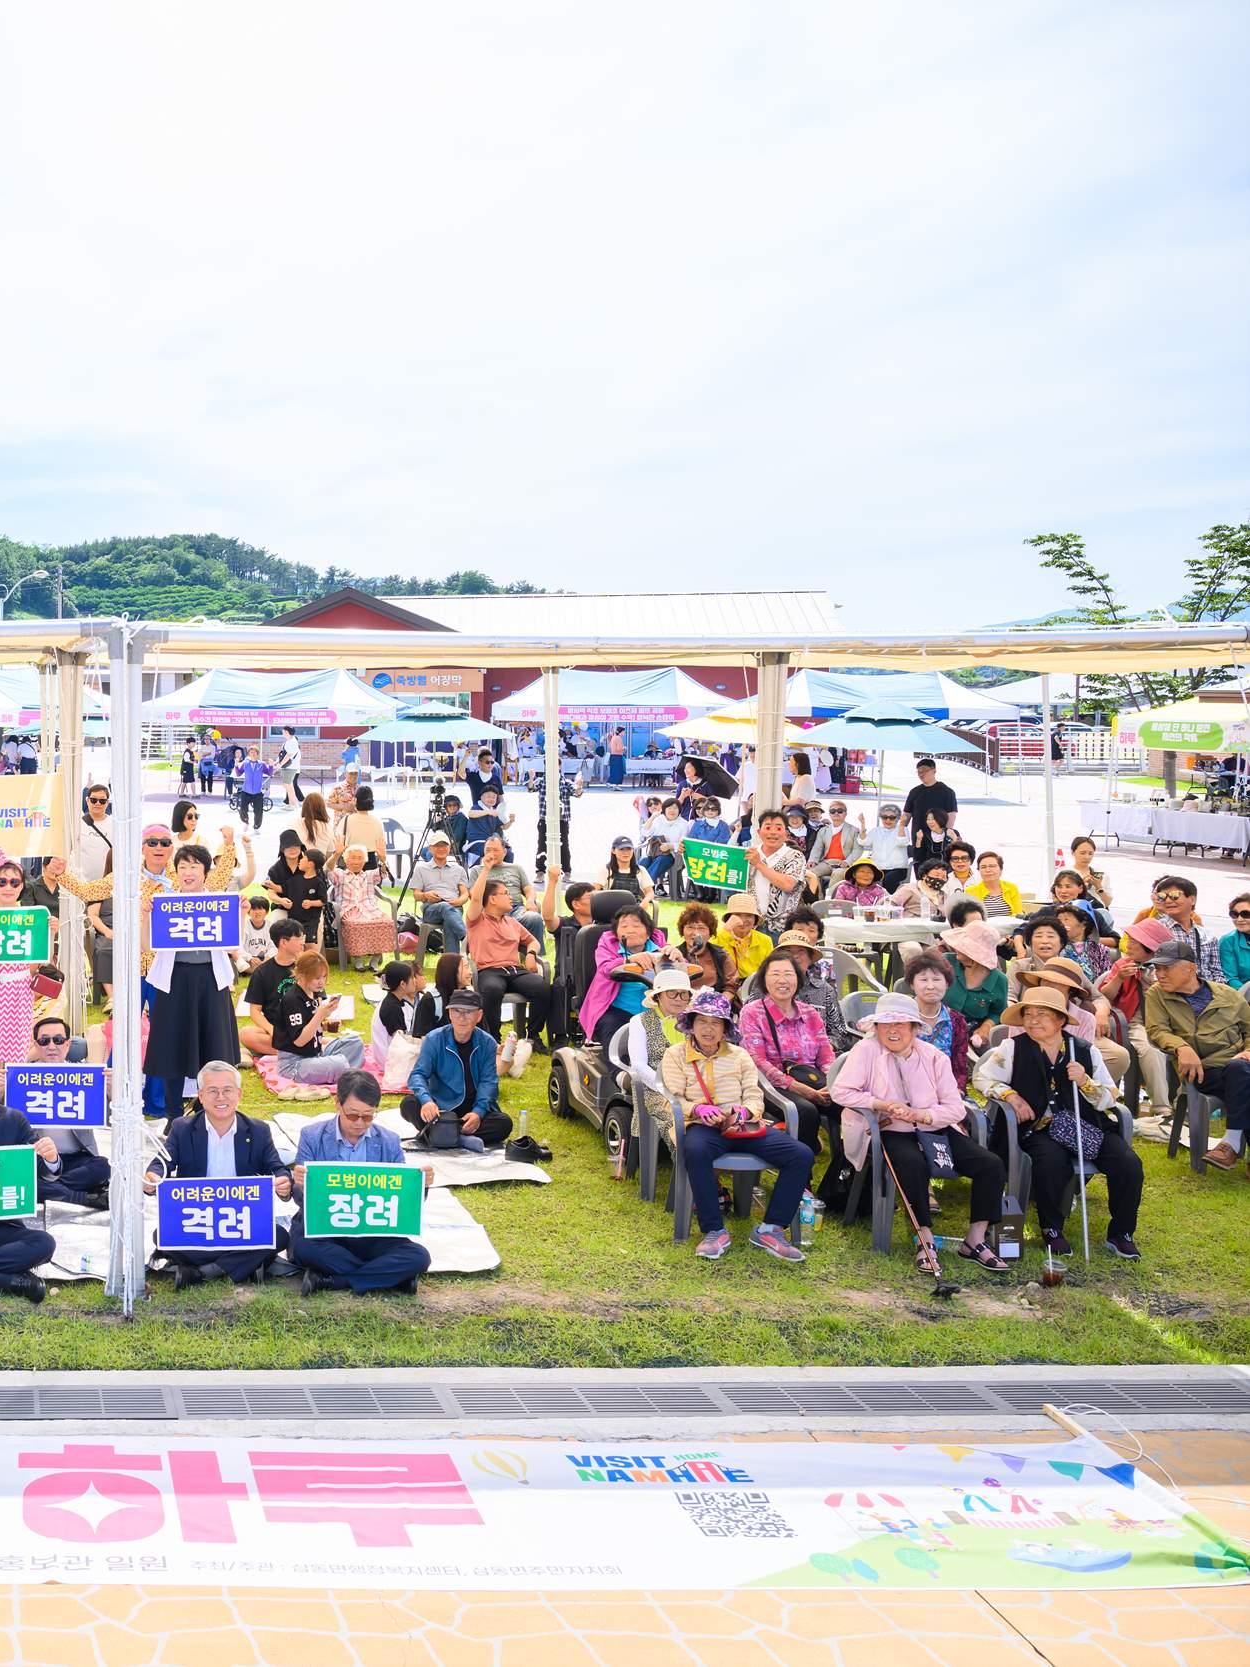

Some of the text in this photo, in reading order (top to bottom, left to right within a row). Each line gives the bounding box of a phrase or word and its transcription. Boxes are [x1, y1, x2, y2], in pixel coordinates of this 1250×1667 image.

[430, 675, 463, 686] 어장막
[702, 847, 729, 860] 모범은
[688, 857, 742, 885] 장려를!
[162, 901, 229, 912] 어려운이에겐
[169, 916, 222, 942] 격려
[289, 1013, 303, 1026] 99
[18, 1074, 93, 1085] 어려운이에겐
[26, 1091, 84, 1119] 격려
[328, 1174, 401, 1189] 모범이에겐
[172, 1186, 259, 1200] 어려운이에겐
[329, 1194, 398, 1227] 장려
[182, 1206, 250, 1240] 격려
[566, 1455, 666, 1468] VISIT
[578, 1461, 754, 1483] NAMHAE
[18, 1444, 486, 1547] 하루
[105, 1554, 168, 1573] 일원
[190, 1559, 274, 1573] 주최/주관
